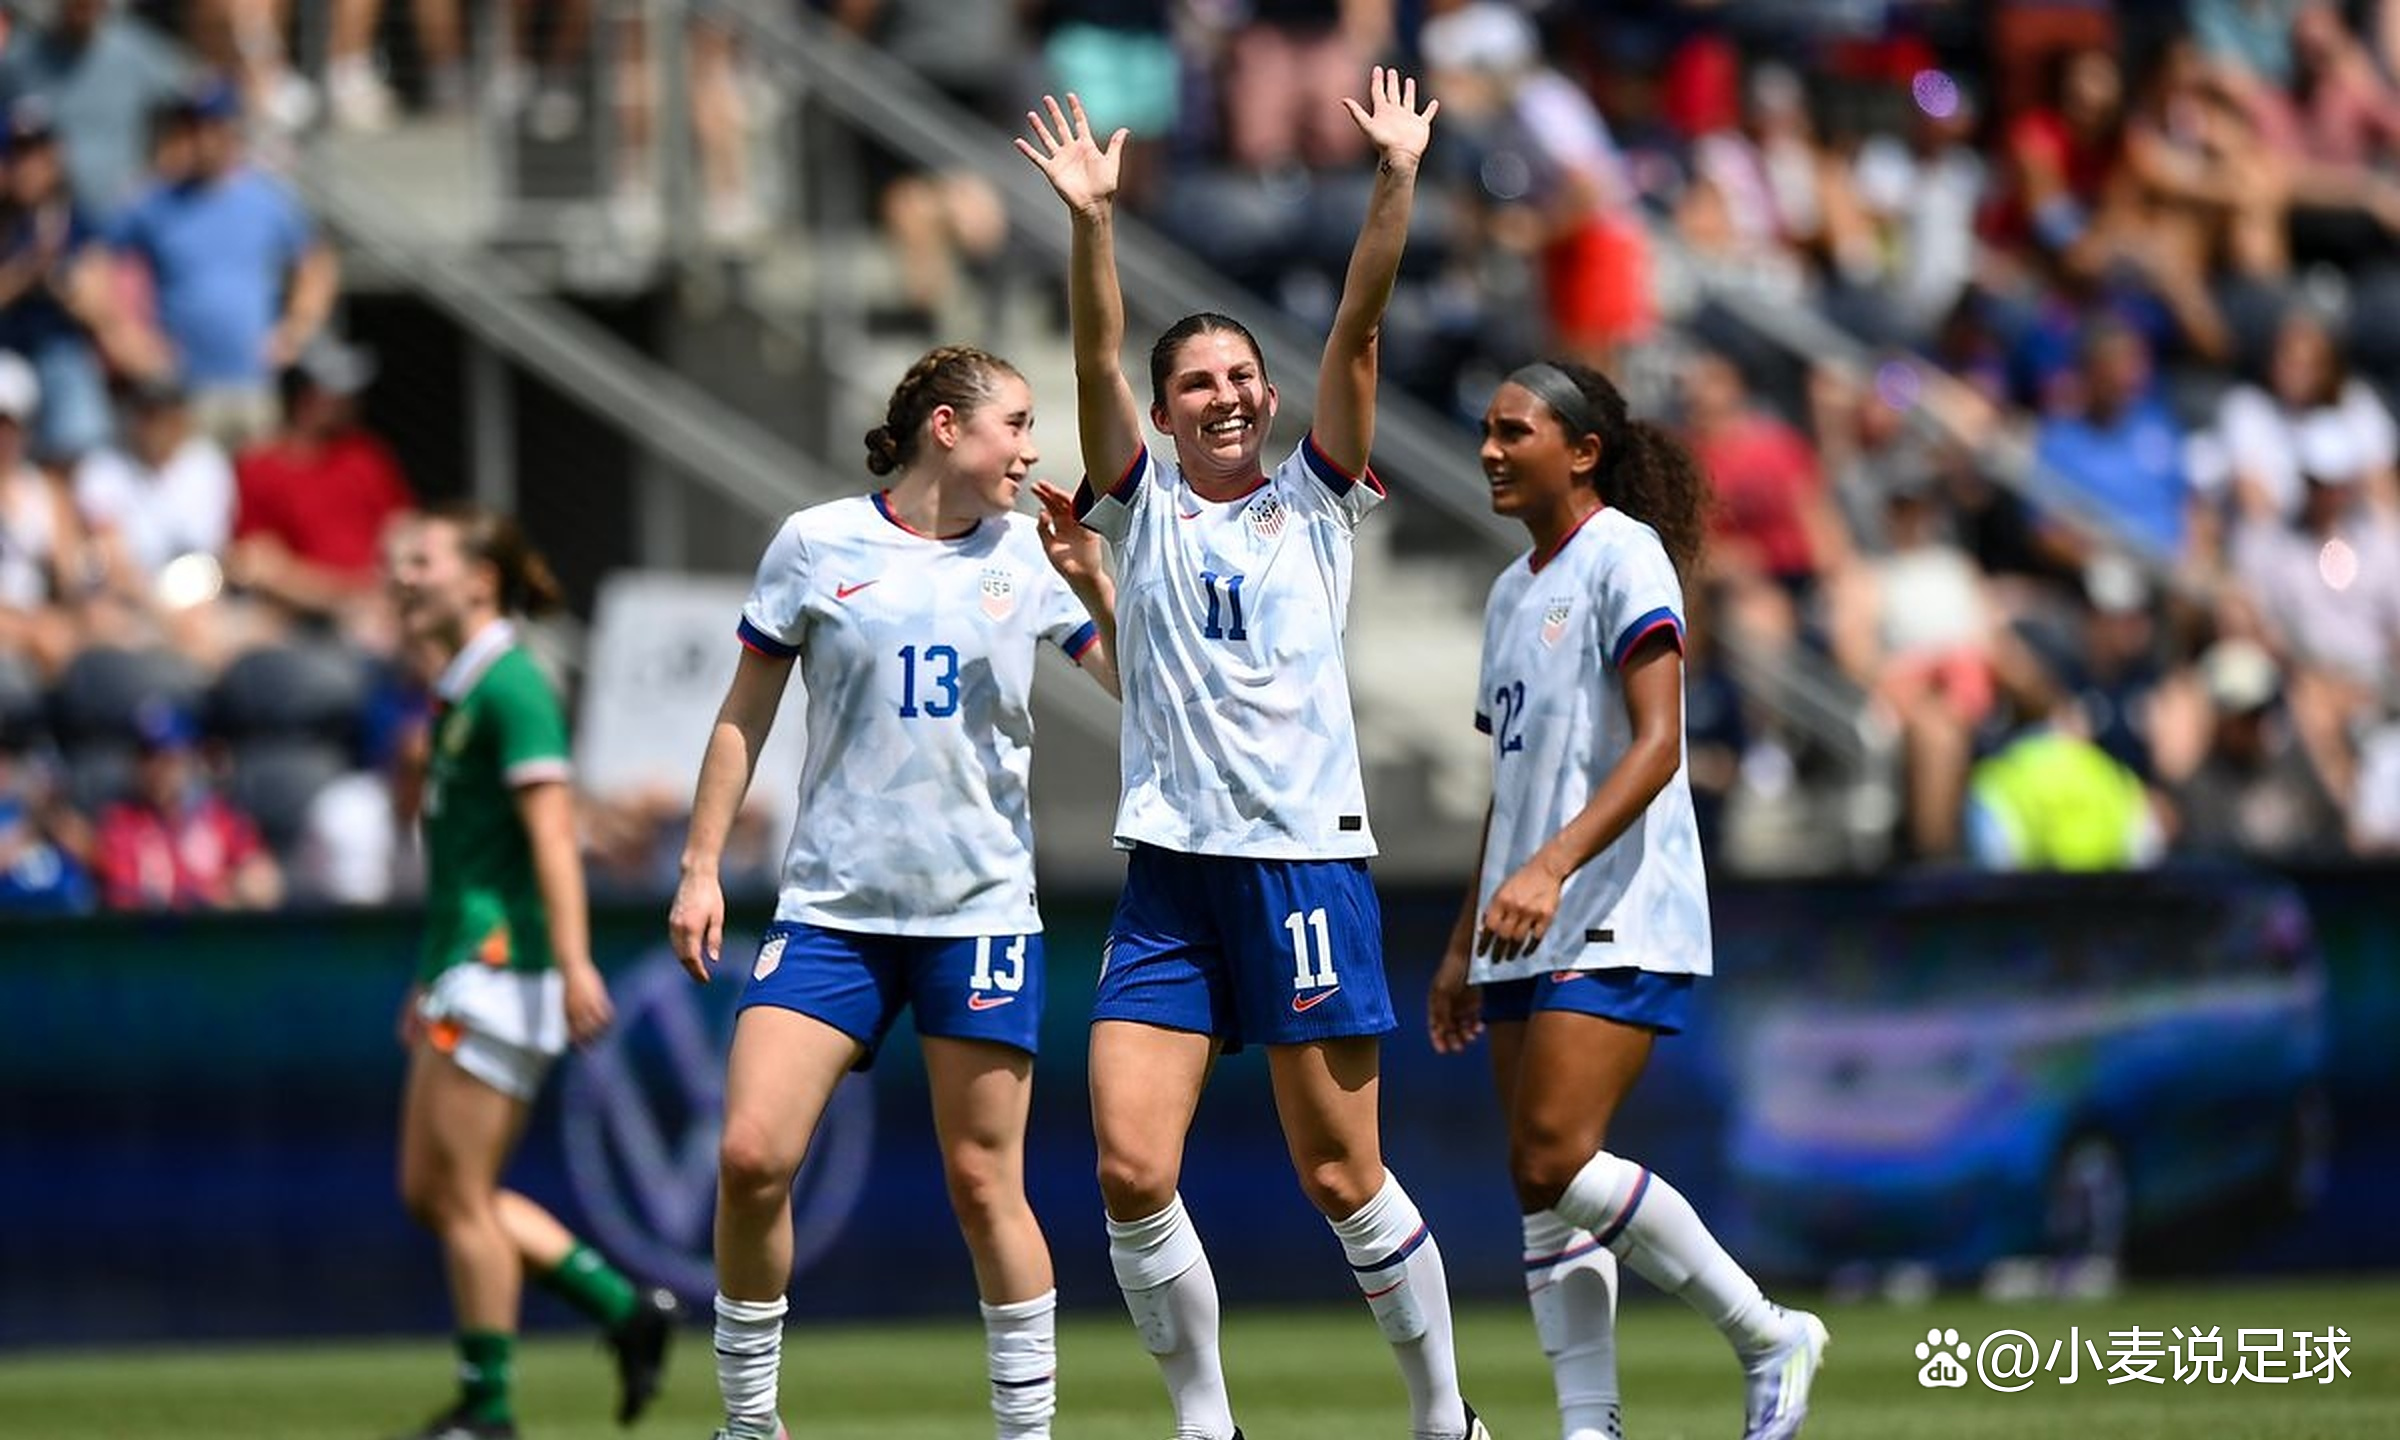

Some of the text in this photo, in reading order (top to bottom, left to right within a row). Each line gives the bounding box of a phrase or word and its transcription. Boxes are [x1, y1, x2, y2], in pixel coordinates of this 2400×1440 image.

[1200, 571, 1247, 641] 11
[897, 645, 960, 718] 13
[1495, 679, 1525, 760] 22
[970, 934, 1026, 992] 13
[1284, 907, 1339, 990] 11
